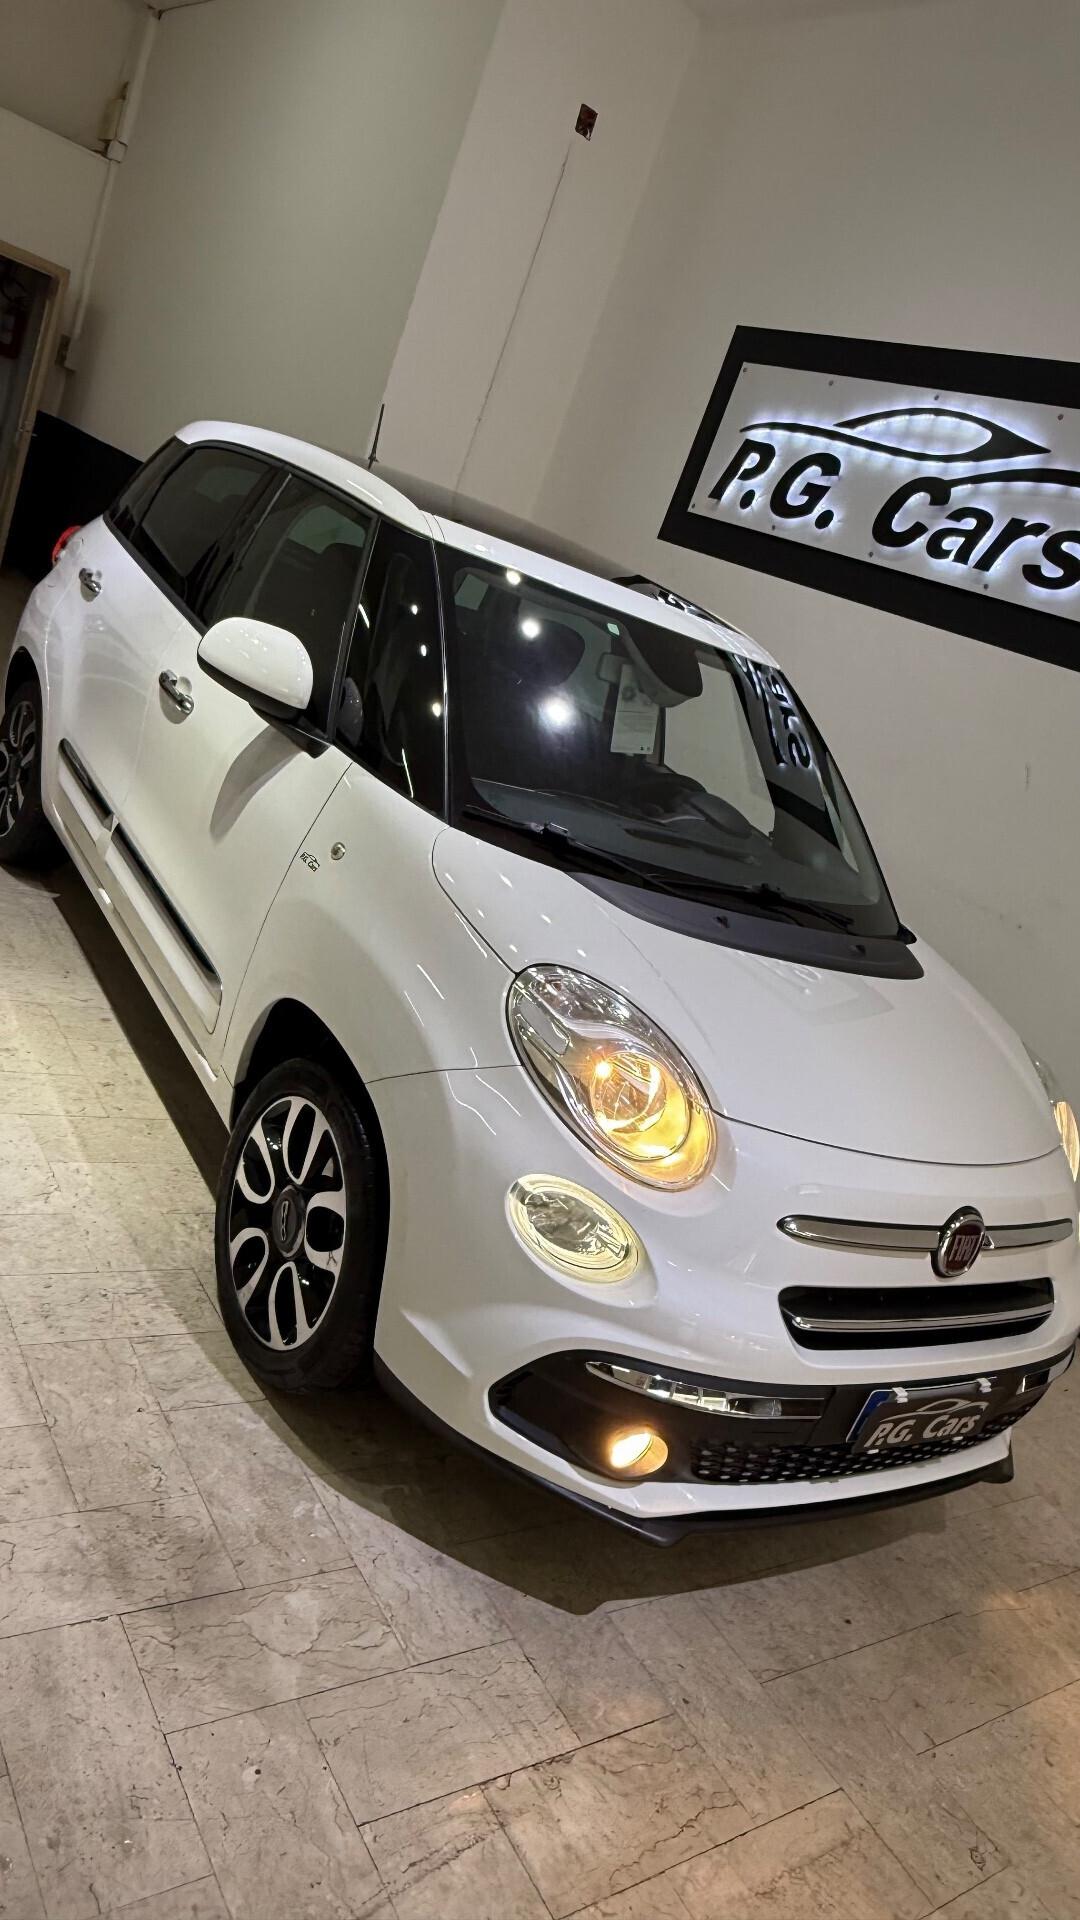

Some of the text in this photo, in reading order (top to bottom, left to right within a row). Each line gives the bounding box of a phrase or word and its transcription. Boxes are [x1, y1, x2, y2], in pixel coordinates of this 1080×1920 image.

[708, 439, 1080, 590] P.G. Cars
[948, 1234, 980, 1261] FIAT
[864, 1415, 981, 1447] P.G. Cars
